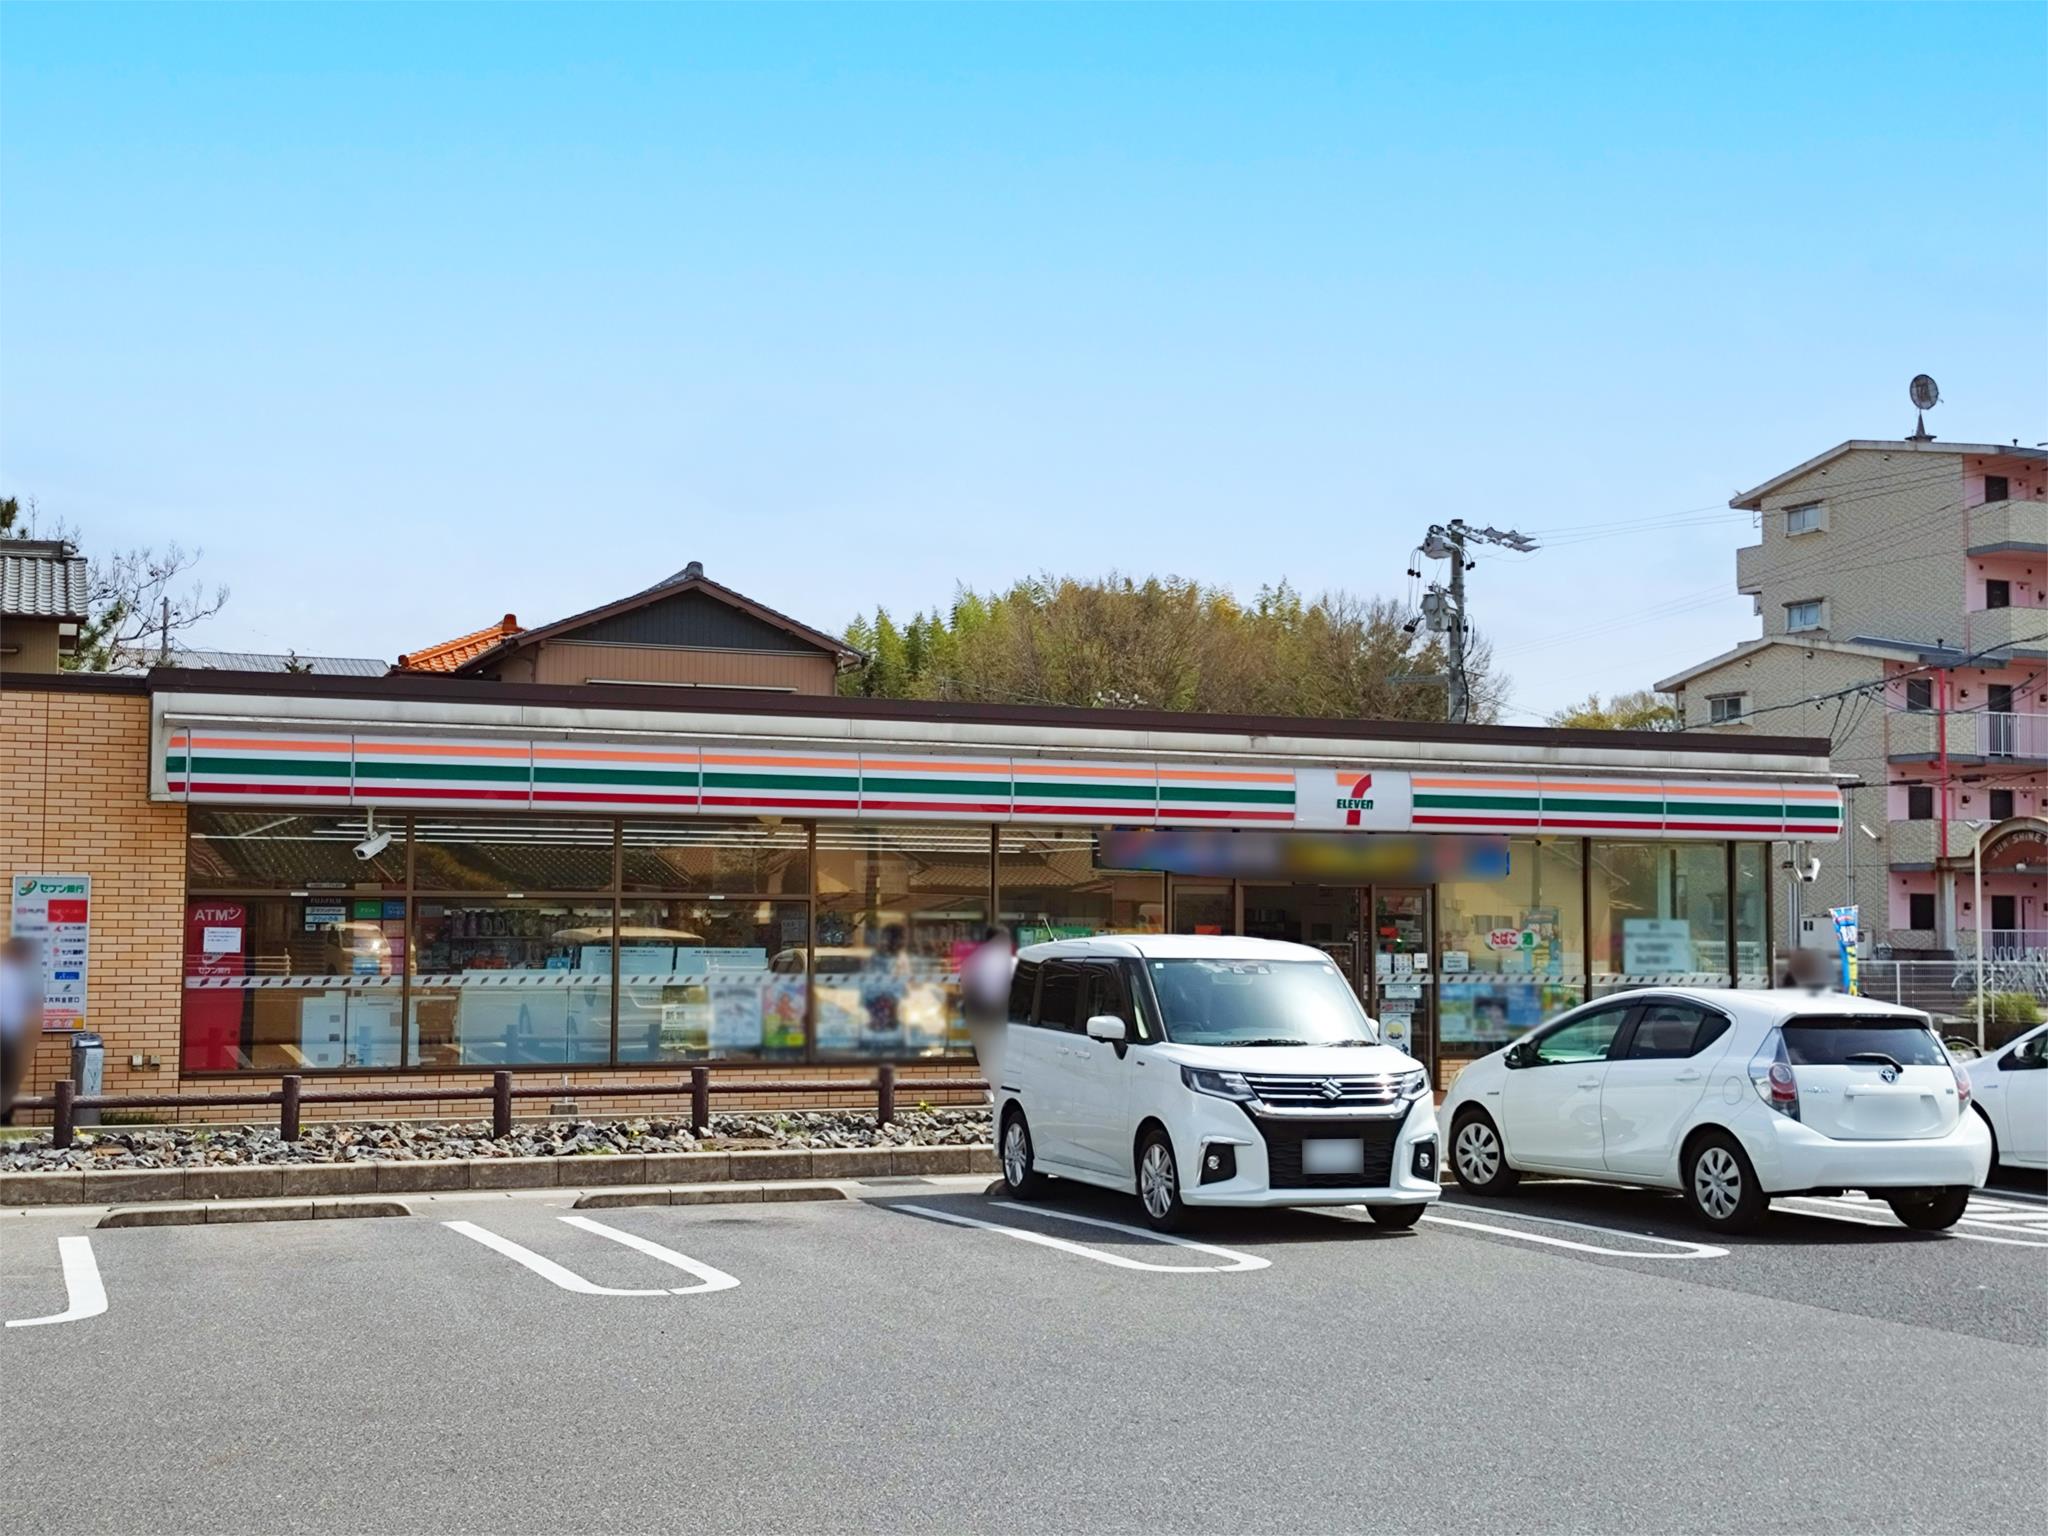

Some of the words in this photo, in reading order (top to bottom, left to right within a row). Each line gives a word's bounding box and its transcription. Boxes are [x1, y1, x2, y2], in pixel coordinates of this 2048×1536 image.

[2012, 831, 2041, 845] SHINE
[40, 884, 85, 894] セブン銀行
[1491, 932, 1517, 945] たばこ
[198, 966, 232, 975] セブン銀行
